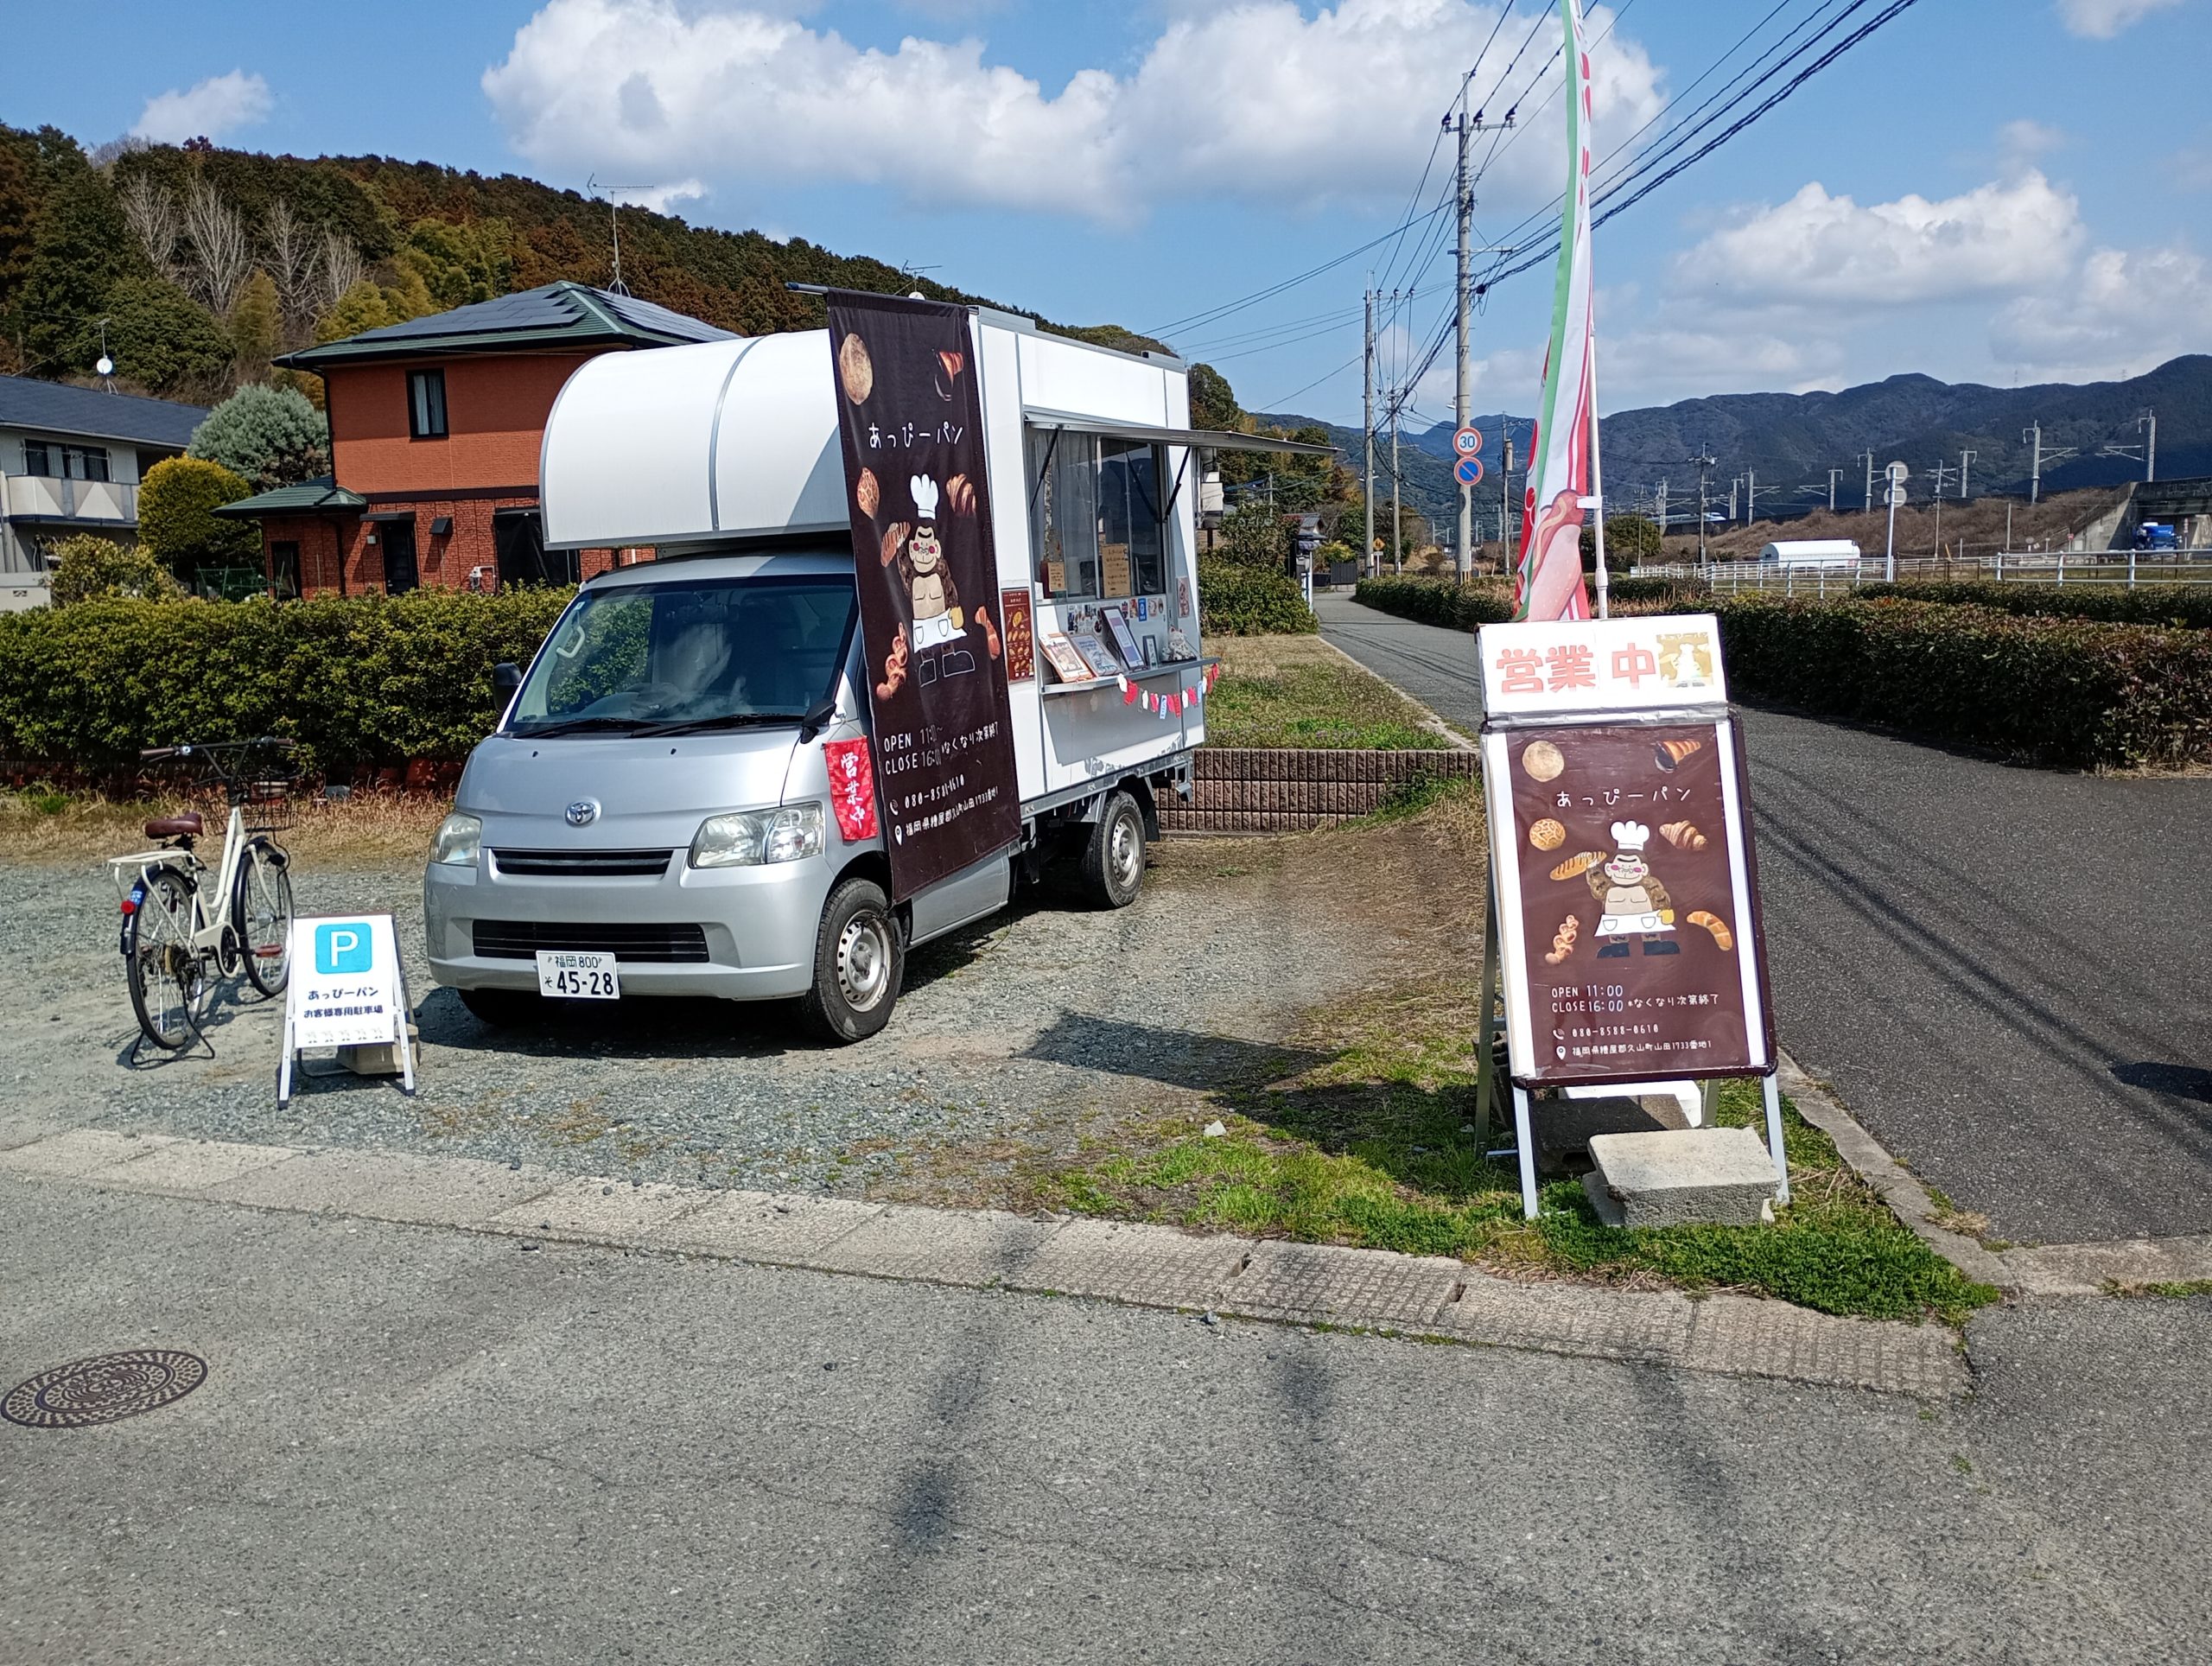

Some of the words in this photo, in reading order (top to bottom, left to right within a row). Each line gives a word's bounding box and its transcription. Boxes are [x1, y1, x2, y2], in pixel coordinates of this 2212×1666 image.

[868, 421, 963, 448] あっぴーパン
[1459, 436, 1475, 448] 30
[1496, 643, 1656, 695] 営業中
[884, 733, 912, 753] OPEN
[885, 753, 918, 775] CLOSE
[841, 751, 866, 830] 営業中
[1555, 785, 1691, 808] あっぴーパン
[331, 931, 359, 967] P
[578, 957, 599, 969] 800
[557, 970, 613, 995] 45-28
[1551, 987, 1579, 998] OPEN
[1586, 984, 1624, 997] 11:00
[308, 987, 378, 1001] あっぴーパン
[304, 1005, 383, 1018] お客様専用駐車場
[1551, 1001, 1586, 1013] CLOSE
[1588, 1000, 1624, 1012] 16:00
[1572, 1024, 1659, 1038] 080-8588-0610
